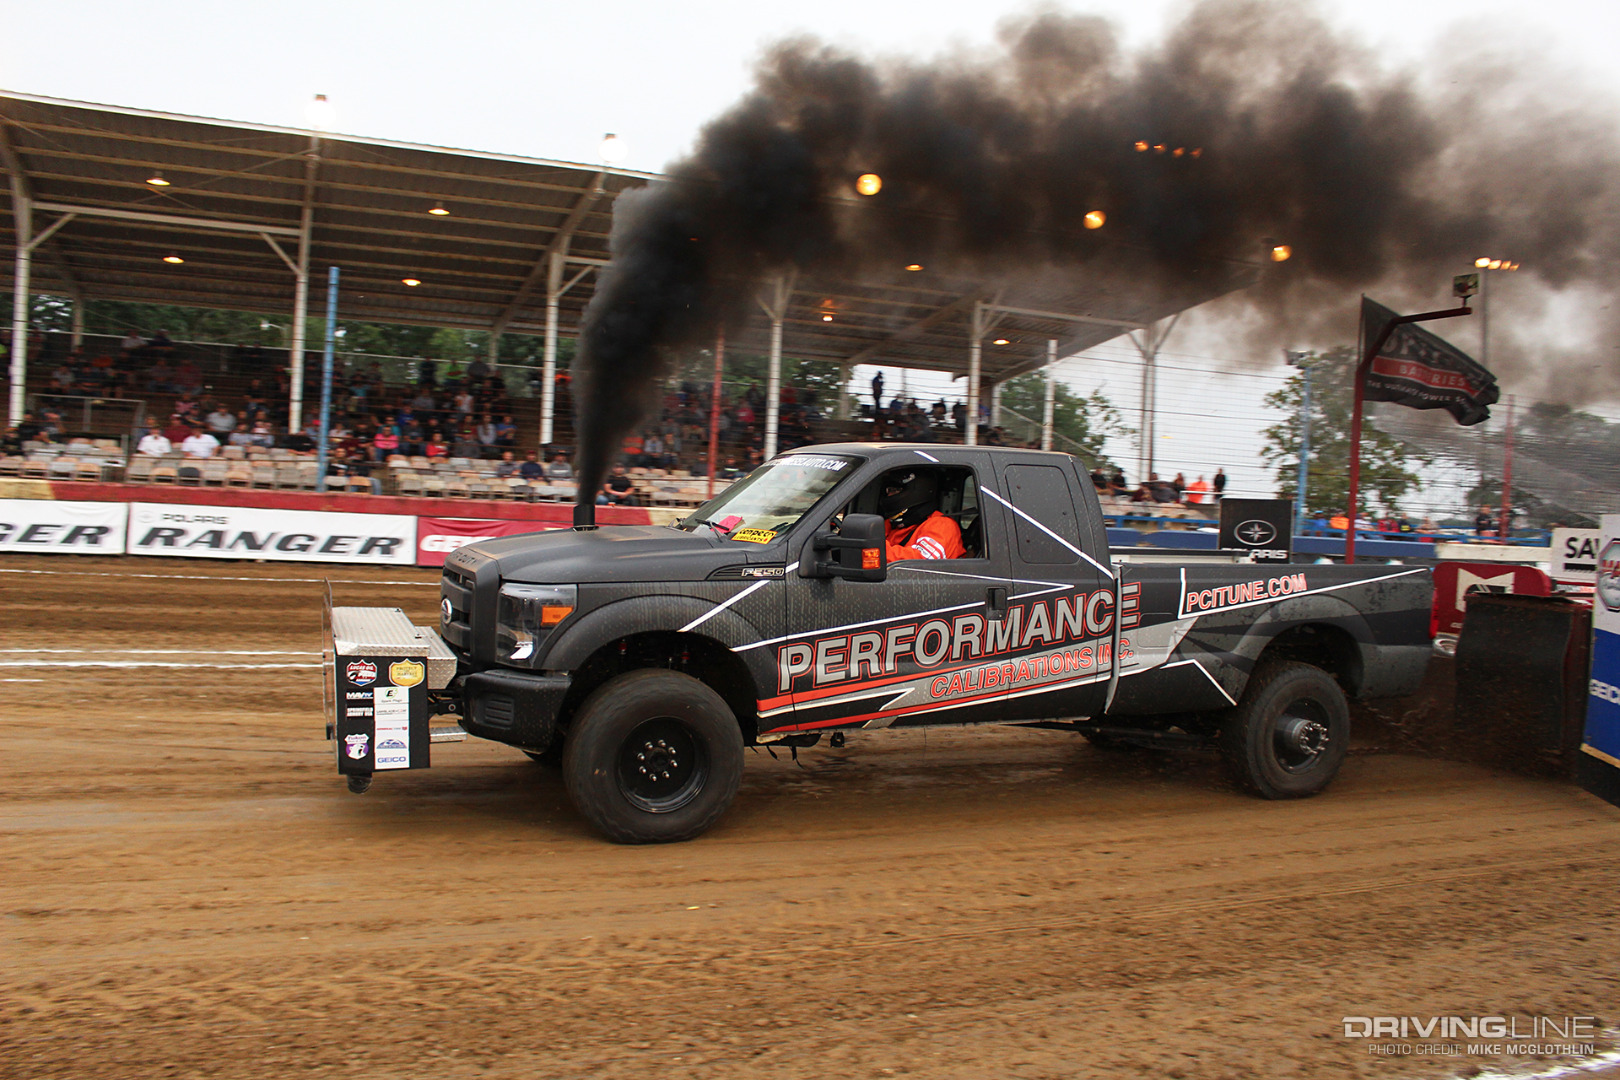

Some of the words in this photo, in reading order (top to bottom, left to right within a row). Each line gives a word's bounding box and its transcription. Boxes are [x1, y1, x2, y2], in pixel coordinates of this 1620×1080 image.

[161, 513, 229, 525] POLARIS
[138, 527, 404, 556] RANGER
[1186, 572, 1307, 612] PCITUNE.COM
[778, 582, 1141, 695] PERFORMANCE
[930, 647, 1093, 698] CALIBRATIONS
[377, 756, 407, 764] GEICO
